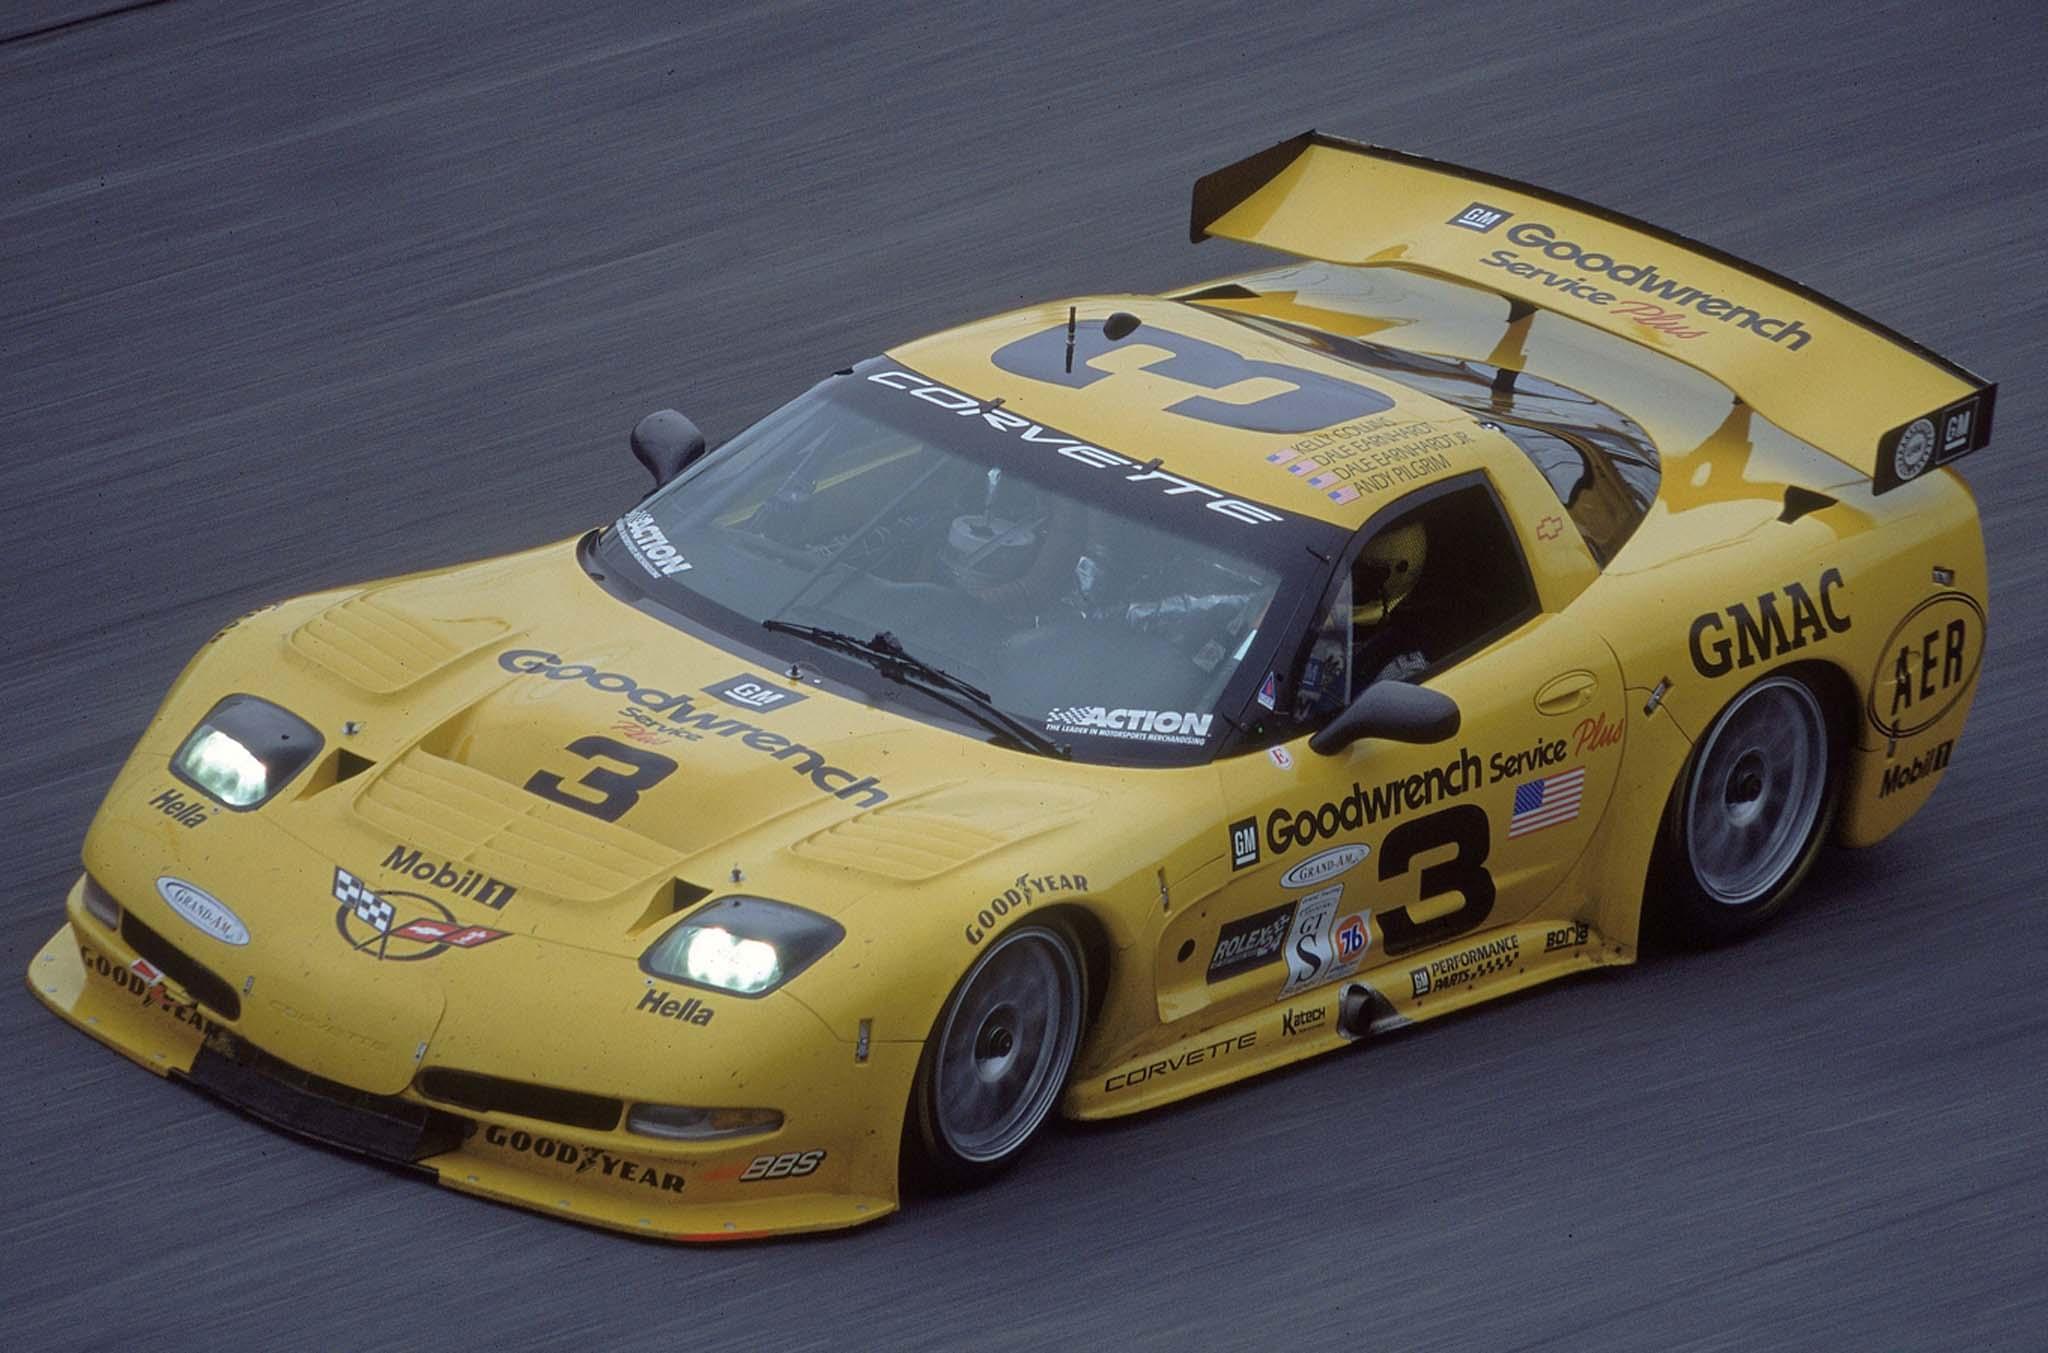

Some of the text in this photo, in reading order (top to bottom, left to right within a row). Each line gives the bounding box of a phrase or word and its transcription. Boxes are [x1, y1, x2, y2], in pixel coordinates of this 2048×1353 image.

[1463, 206, 1502, 228] GM
[1479, 249, 1709, 341] Service Plus
[1506, 222, 1814, 352] Goodwrench
[990, 318, 1397, 435] 3
[867, 371, 1285, 525] CORVETTE
[1290, 433, 1336, 456] KELLY
[1312, 421, 1437, 467] DALE EARNHARDT
[1945, 410, 1971, 443] GM
[1332, 457, 1376, 482] DALE
[1372, 433, 1459, 470] EARNHARDT
[1353, 452, 1452, 498] ANDY PILGRIM
[626, 515, 693, 575] ACTION
[1689, 567, 1852, 679] GMAC
[1891, 618, 1966, 717] AER
[724, 681, 787, 709] GM
[497, 648, 890, 809] Goodwrench
[616, 705, 705, 742] Service
[1077, 706, 1214, 737] ACTION
[523, 735, 679, 823] 3
[1267, 712, 1624, 855] Goodwrench Service Plus
[1878, 747, 1936, 799] Mobil
[148, 788, 209, 829] Hella
[1233, 827, 1256, 858] GM
[380, 844, 485, 898] Mobil
[1376, 803, 1497, 957] 3
[174, 888, 231, 935] GRAND-AM
[965, 873, 1089, 946] GOODYEAR
[1300, 911, 1328, 935] GT
[1295, 933, 1321, 986] S
[1341, 924, 1363, 955] 76
[1431, 934, 1519, 977] PERFORMANCE
[636, 988, 715, 1026] Hella
[1104, 1032, 1257, 1094] CORVETTE
[485, 1125, 686, 1194] GOODYEAR
[740, 1148, 827, 1182] BBS
